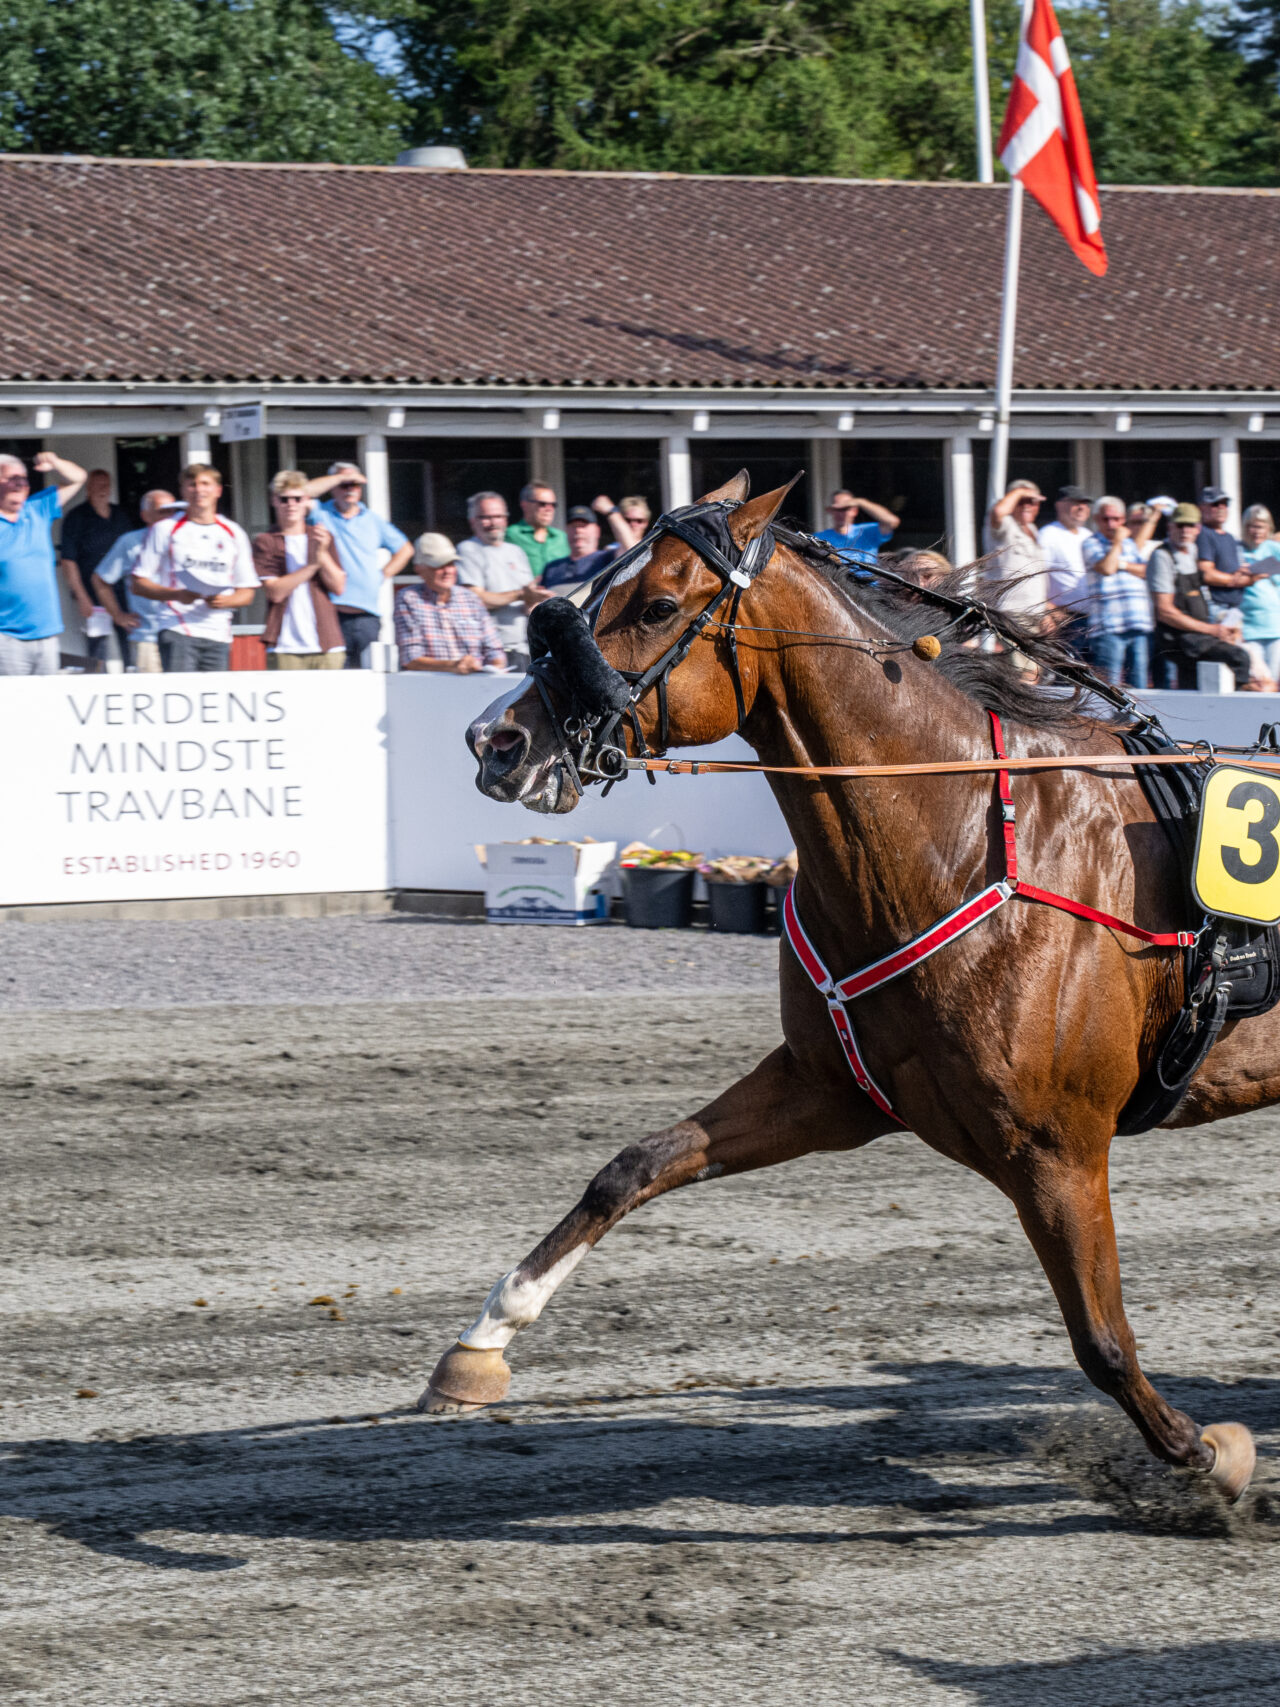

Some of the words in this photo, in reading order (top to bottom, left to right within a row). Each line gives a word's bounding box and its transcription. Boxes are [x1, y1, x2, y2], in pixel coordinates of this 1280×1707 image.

[66, 690, 286, 725] VERDENS
[70, 738, 286, 774] MINDSTE
[56, 785, 303, 823] TRAVBANE
[1221, 781, 1280, 884] 3
[63, 852, 232, 875] ESTABLISHED
[240, 850, 301, 869] 1960
